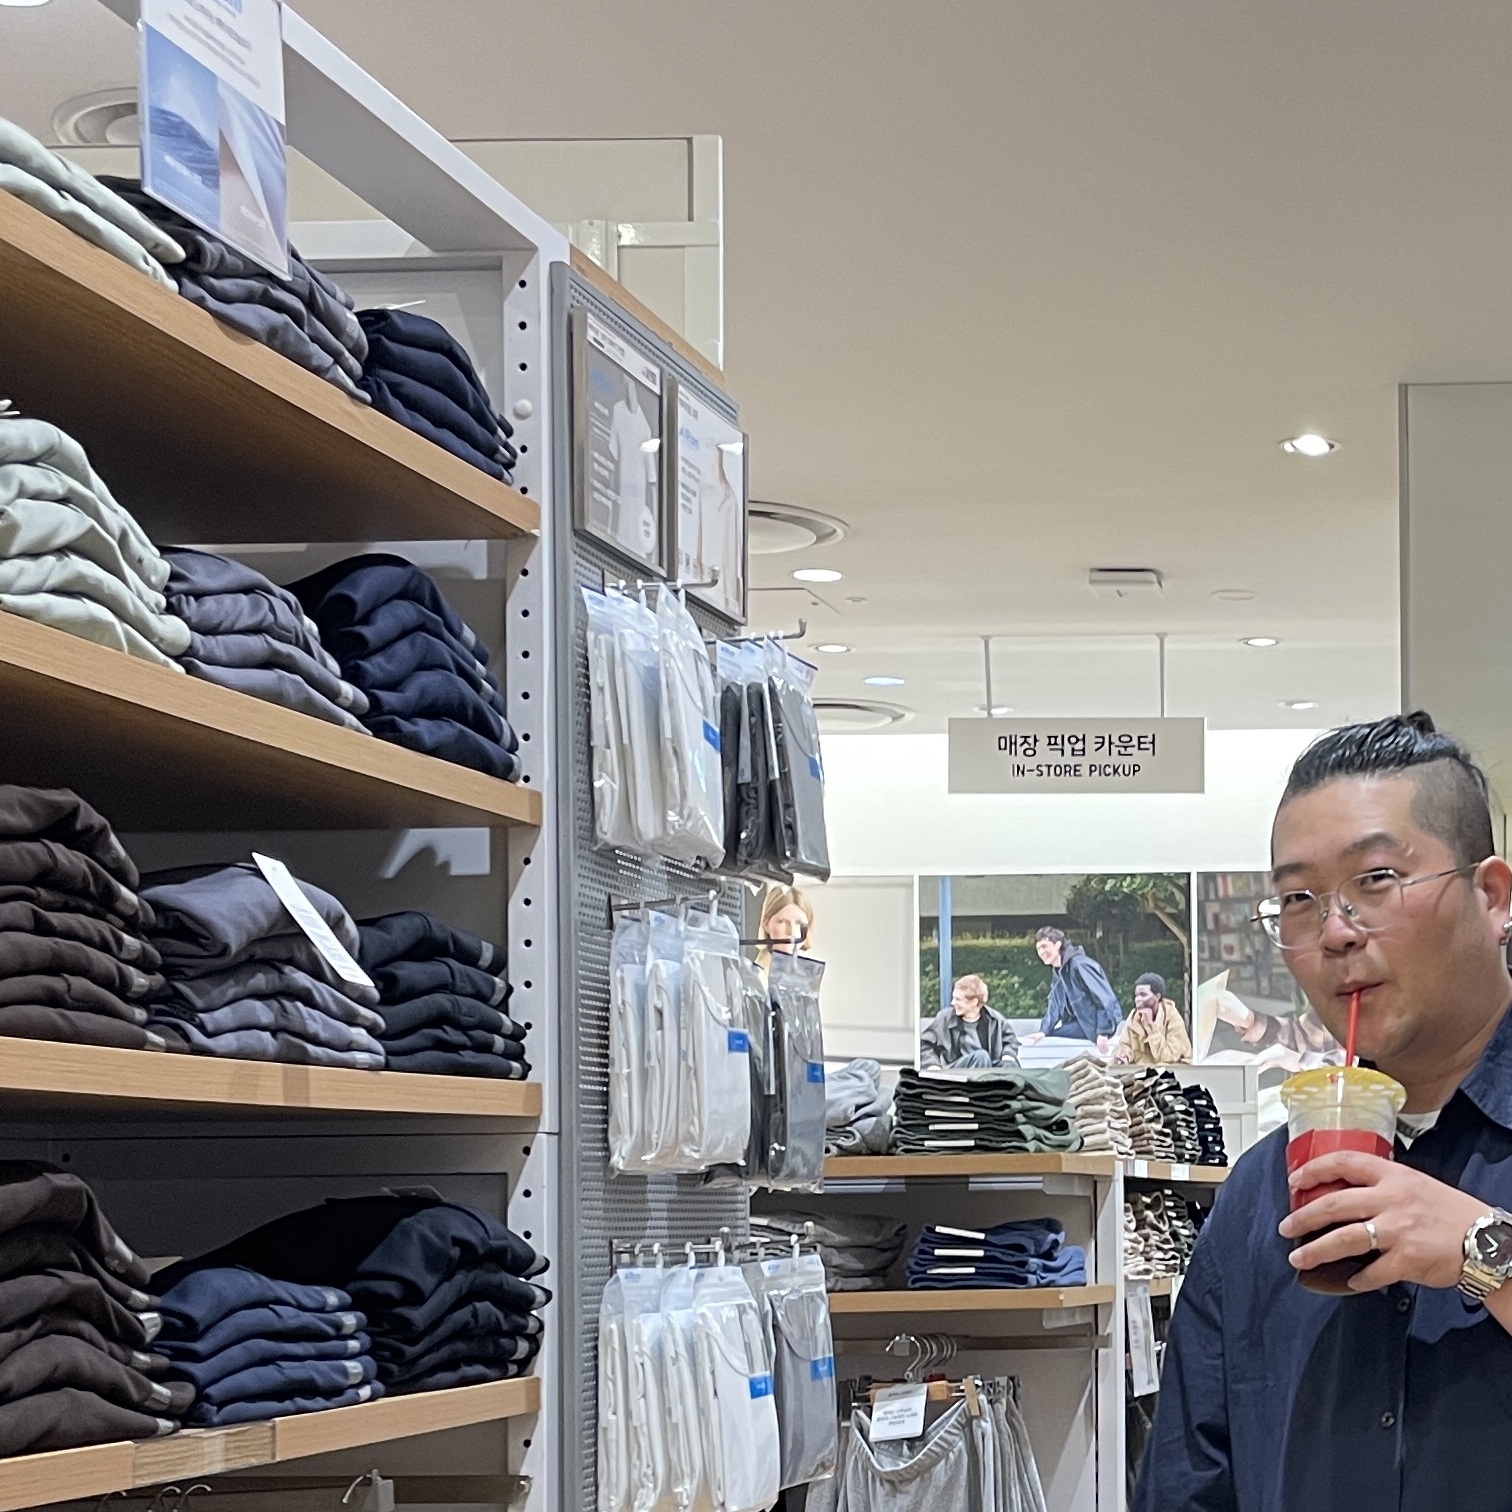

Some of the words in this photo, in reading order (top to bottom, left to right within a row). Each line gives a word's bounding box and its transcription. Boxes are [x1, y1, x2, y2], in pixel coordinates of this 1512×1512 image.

[997, 733, 1039, 757] 매장
[1046, 733, 1087, 757] 픽업
[1094, 733, 1156, 757] 카운터
[1012, 763, 1083, 778] IN-STORE
[1088, 763, 1141, 778] PICKUP
